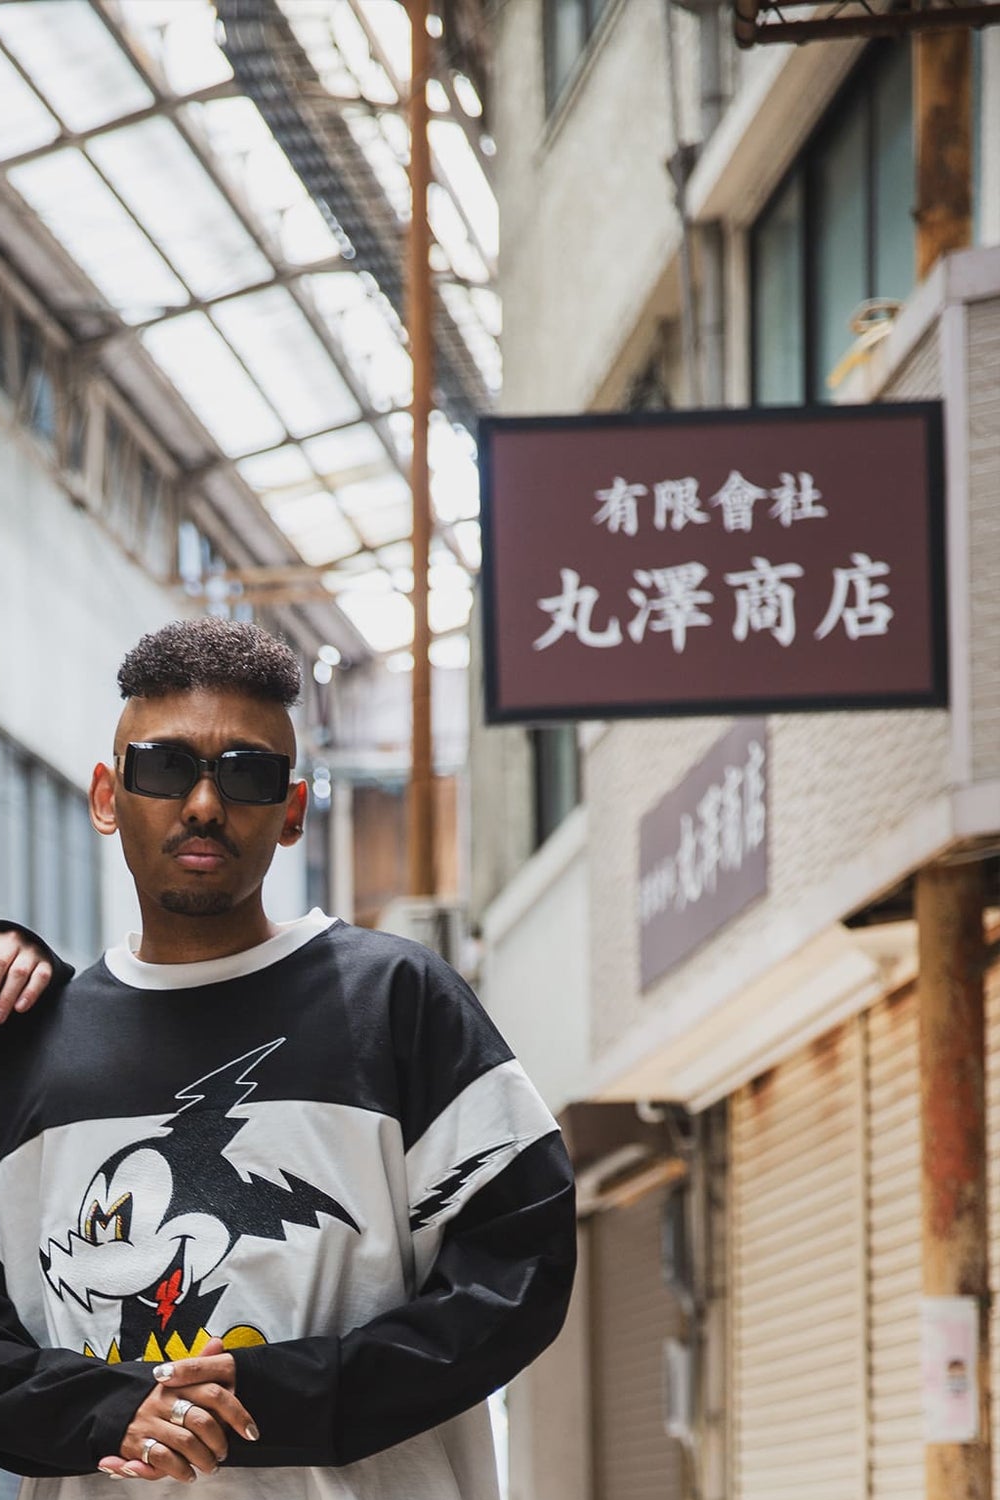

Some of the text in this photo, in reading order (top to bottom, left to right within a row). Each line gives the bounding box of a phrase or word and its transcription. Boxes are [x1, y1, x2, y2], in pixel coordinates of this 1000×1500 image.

[594, 470, 828, 536] 有限會社
[531, 552, 895, 653] 丸澤商店
